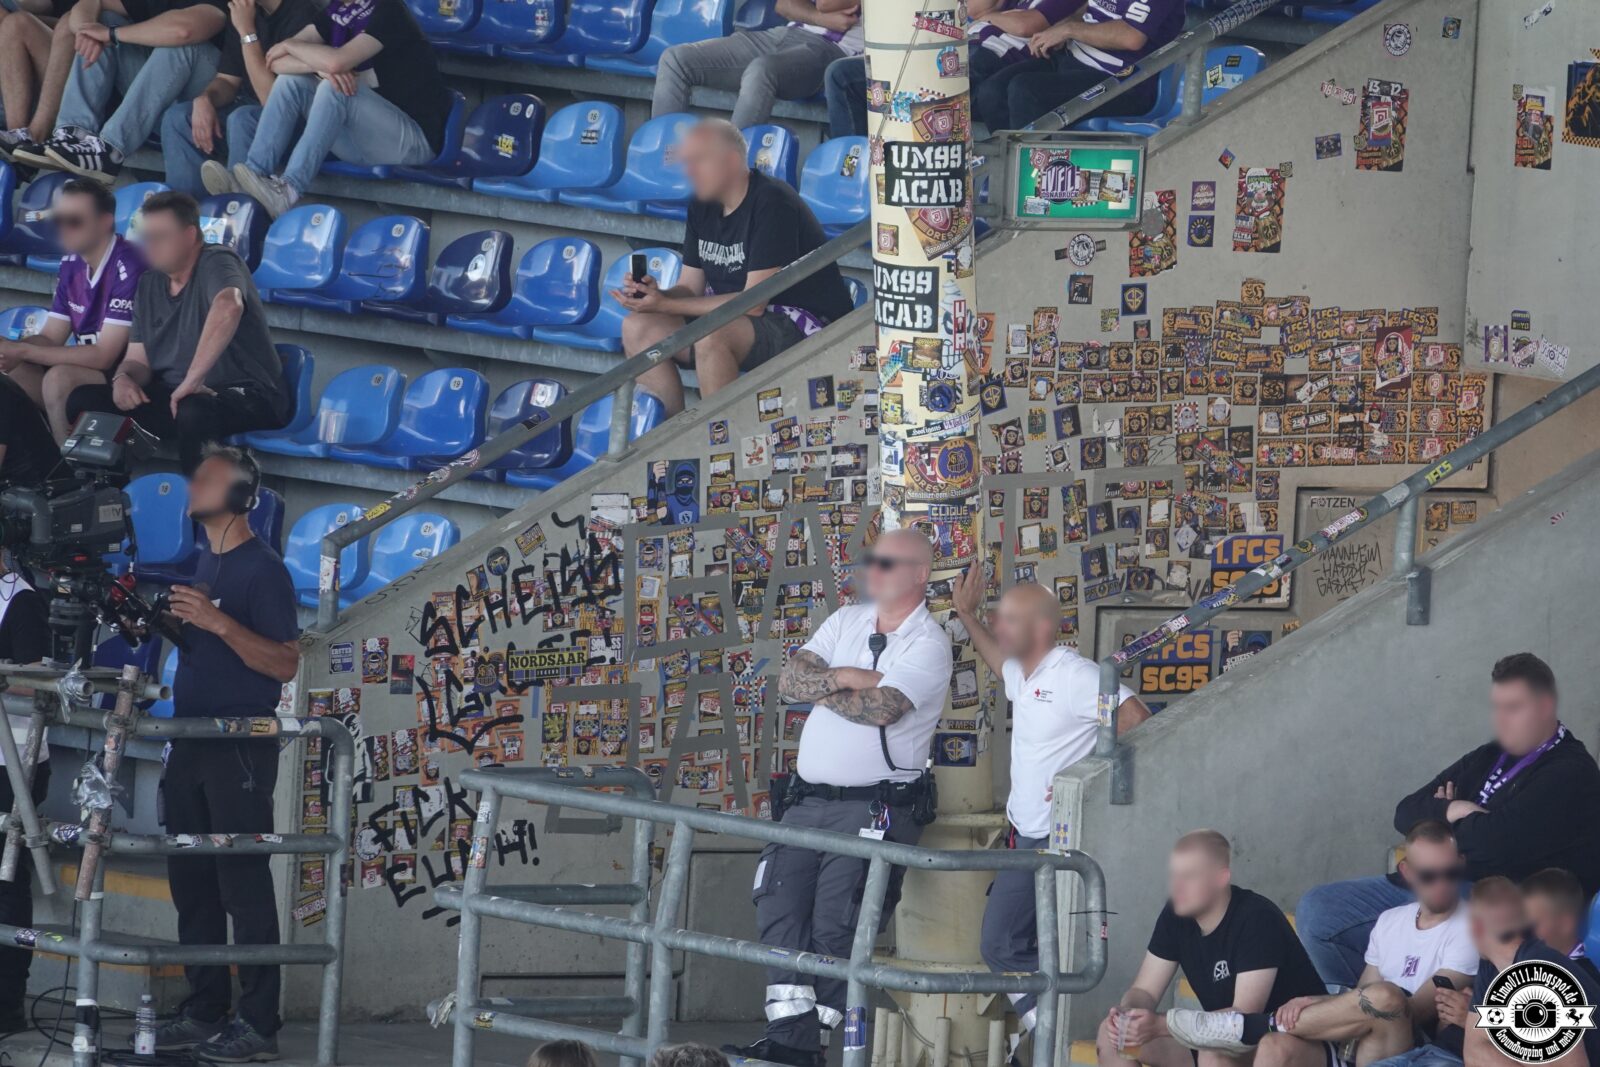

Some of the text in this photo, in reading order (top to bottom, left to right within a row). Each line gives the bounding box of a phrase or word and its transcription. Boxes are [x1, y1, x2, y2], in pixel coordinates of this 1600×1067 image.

[891, 144, 962, 169] UM99
[891, 178, 963, 204] ACAB
[874, 264, 933, 294] UM99
[874, 298, 933, 329] ACAB
[1317, 329, 1340, 340] TOUR
[1288, 339, 1312, 353] TOUR
[1216, 350, 1240, 362] TOUR
[1312, 377, 1329, 392] ANS
[87, 419, 97, 431] 2
[1309, 412, 1327, 424] ANS
[931, 506, 969, 516] CLIQUE
[1310, 497, 1356, 508] FOTZEN
[1319, 542, 1382, 567] MANNHEIM
[1126, 630, 1164, 655] ULTRAS
[509, 651, 587, 670] NORDSAAR
[1142, 666, 1209, 692] SC95
[369, 776, 477, 852] FICK
